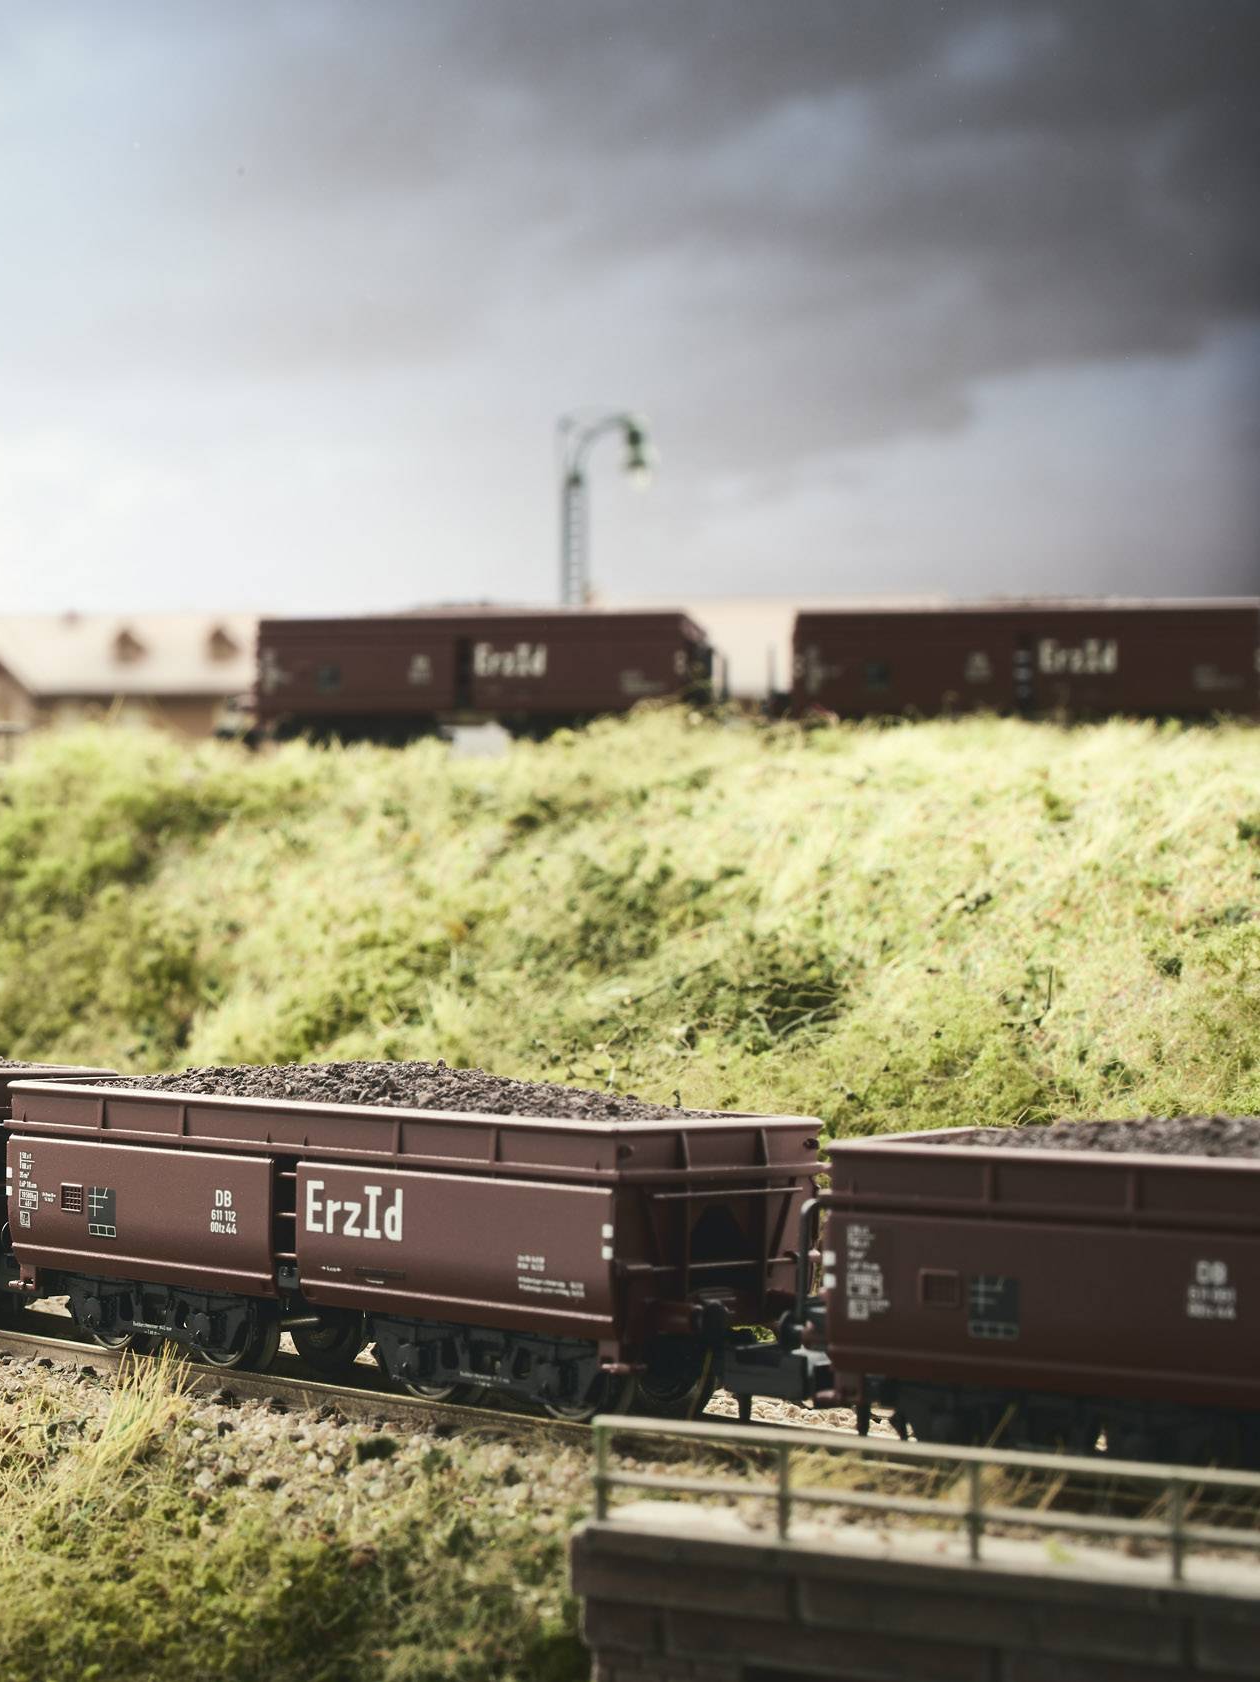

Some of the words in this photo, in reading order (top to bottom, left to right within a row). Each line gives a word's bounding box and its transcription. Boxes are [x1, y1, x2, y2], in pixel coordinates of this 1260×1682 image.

[215, 1189, 232, 1208] DB
[210, 1209, 223, 1221] 611
[224, 1210, 237, 1223] 112
[306, 1180, 404, 1242] ErzId
